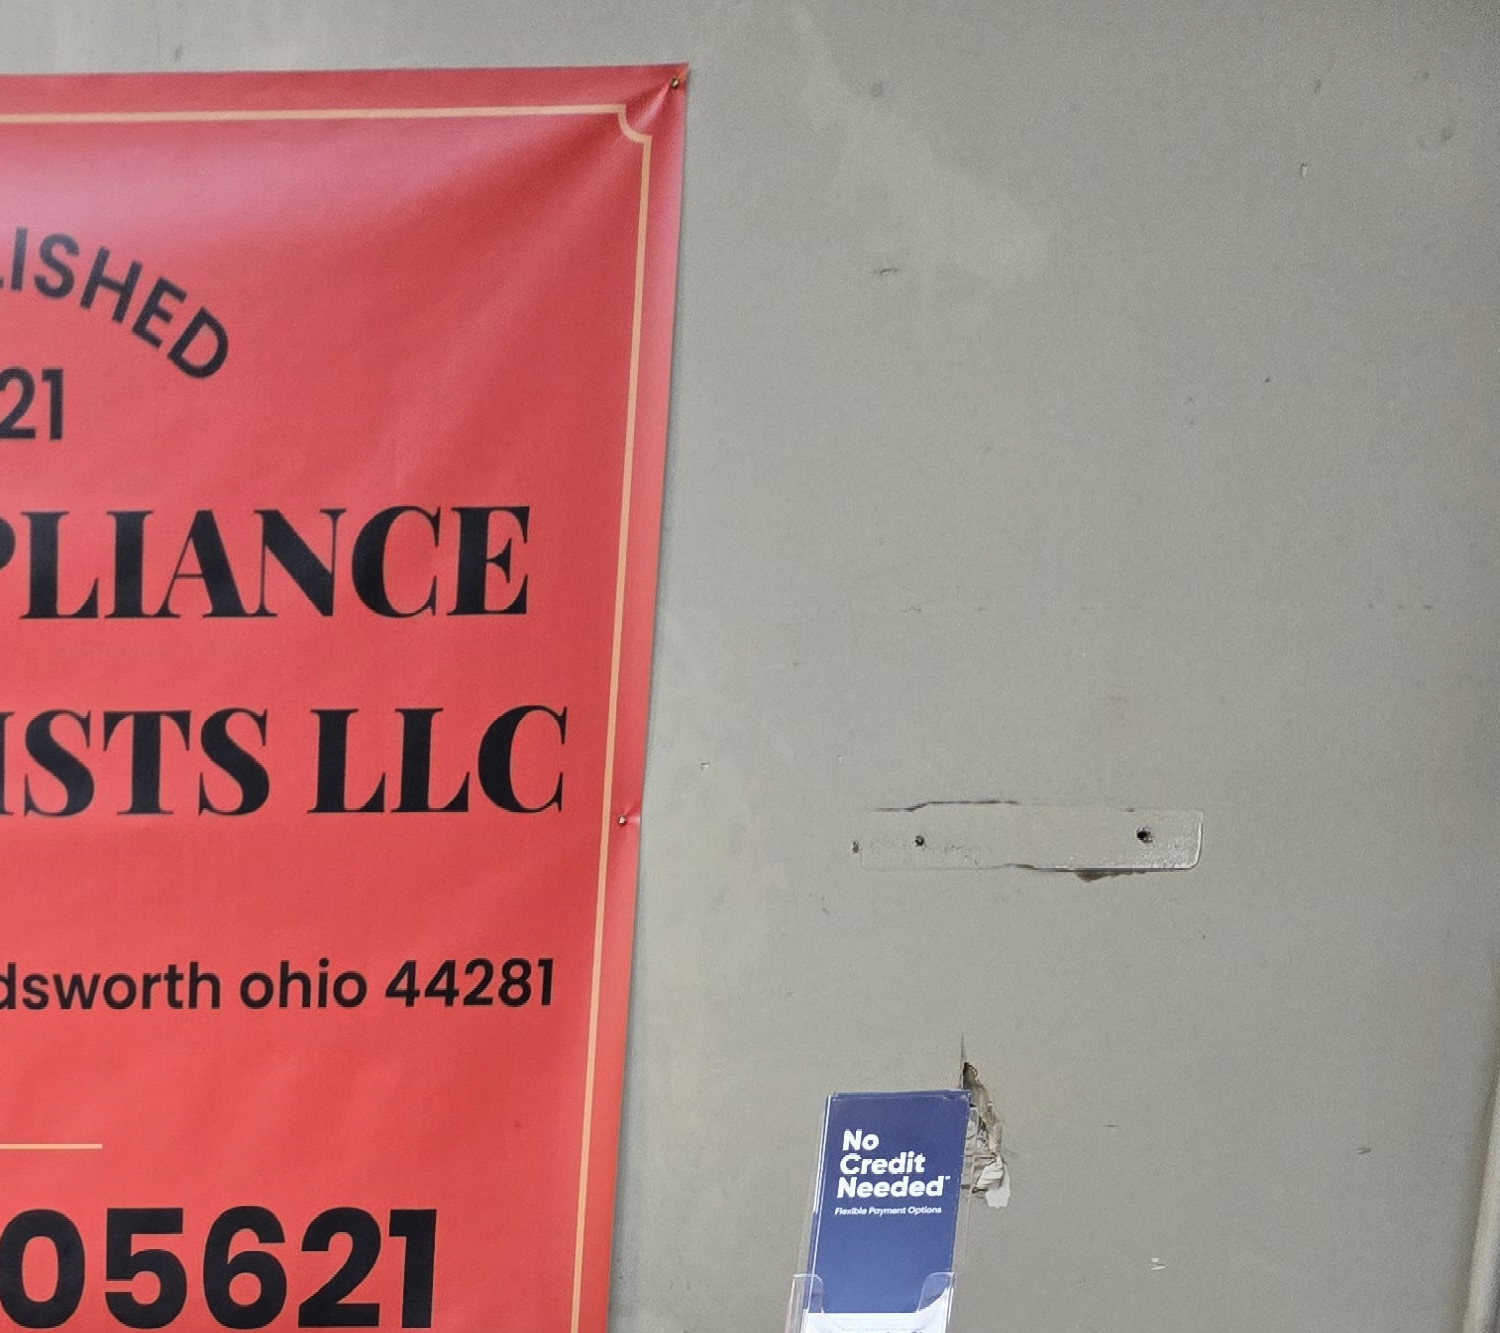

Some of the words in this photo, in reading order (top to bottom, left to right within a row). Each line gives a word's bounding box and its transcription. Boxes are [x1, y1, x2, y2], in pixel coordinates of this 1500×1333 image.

[308, 704, 570, 816] LLC
[239, 960, 367, 1009] ohio
[385, 958, 554, 1009] 44281
[843, 1129, 879, 1150] No
[840, 1151, 925, 1174] Credit
[835, 1207, 867, 1215] Flexible
[869, 1207, 906, 1217] Payment
[908, 1206, 941, 1214] Options
